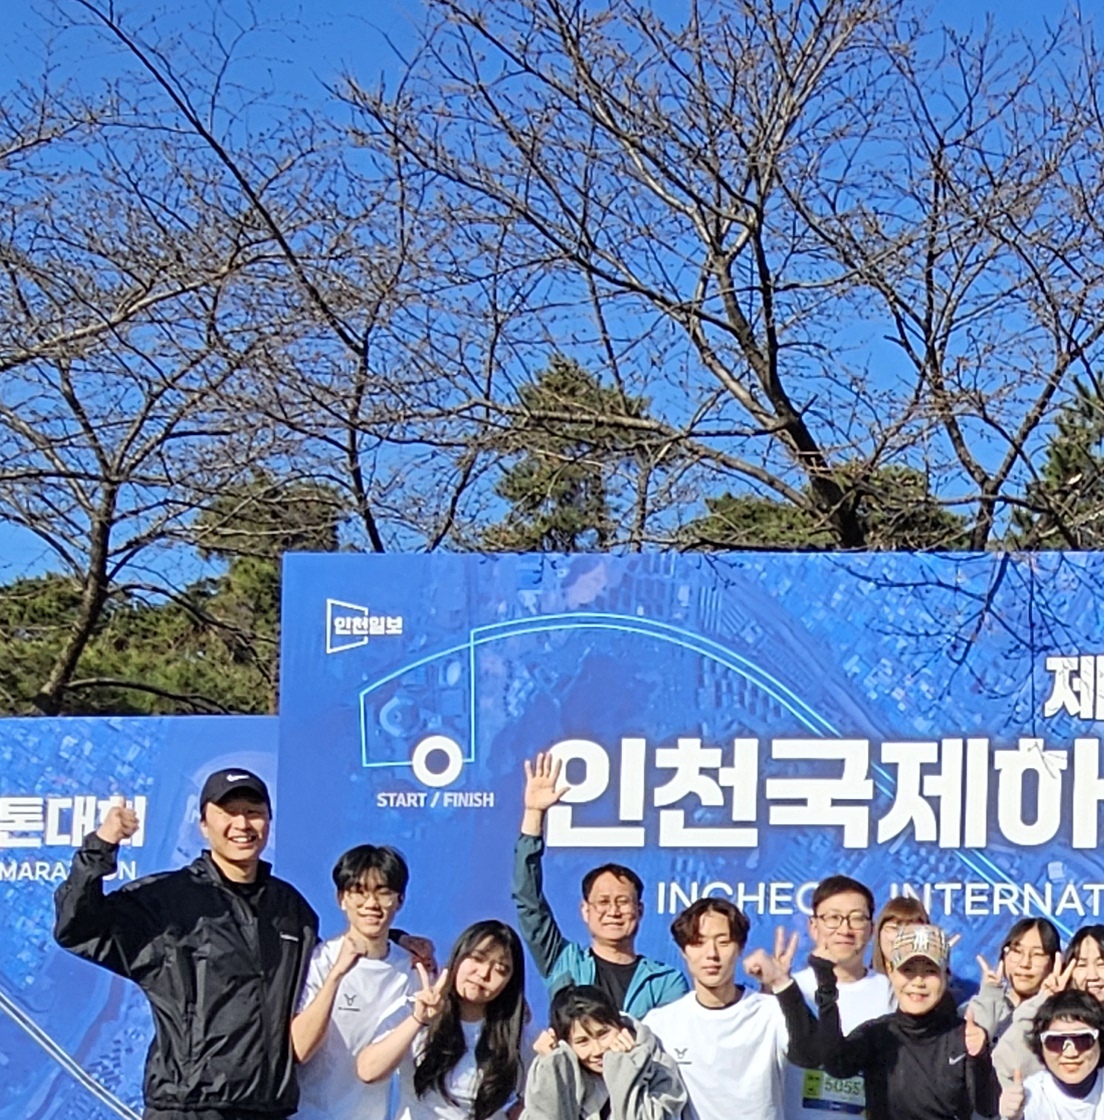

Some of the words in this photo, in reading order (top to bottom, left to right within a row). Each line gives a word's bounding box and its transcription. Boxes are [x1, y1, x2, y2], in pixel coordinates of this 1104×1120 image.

[334, 616, 403, 635] 인천일보
[376, 792, 428, 808] START
[443, 792, 495, 808] FINISH
[0, 860, 137, 882] MARAN
[824, 1080, 862, 1097] 5055
